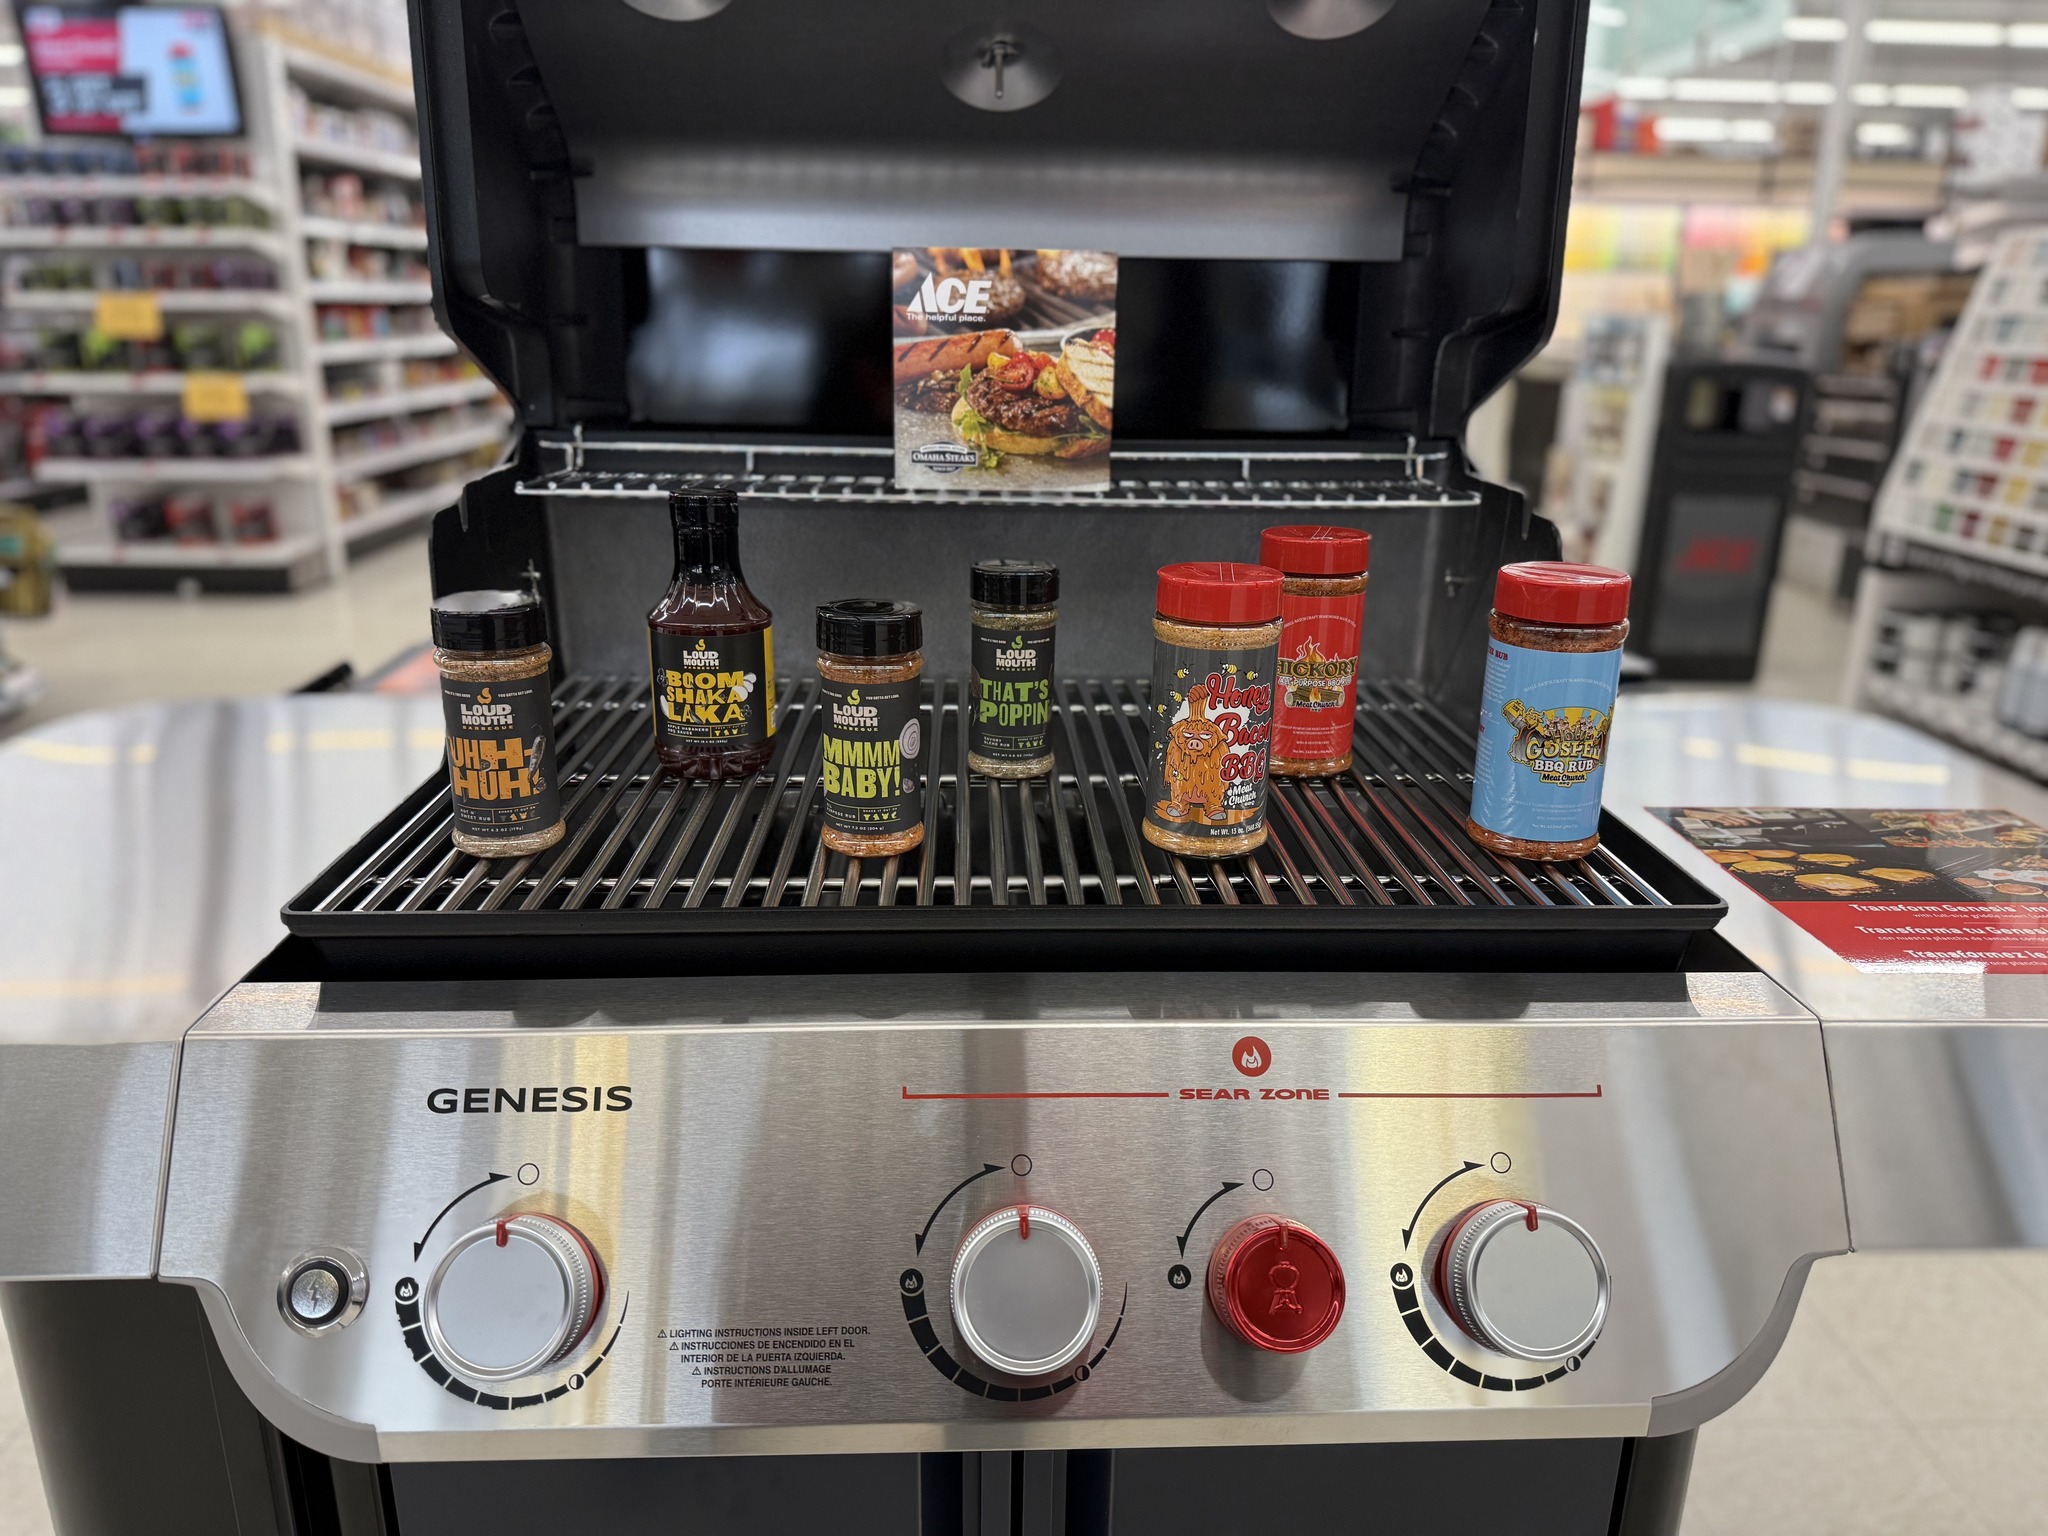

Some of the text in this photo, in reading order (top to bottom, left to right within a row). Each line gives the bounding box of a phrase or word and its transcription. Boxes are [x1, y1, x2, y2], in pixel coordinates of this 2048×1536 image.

[906, 271, 992, 314] ACE
[925, 313, 957, 322] helpful
[959, 314, 986, 322] place.
[912, 452, 975, 462] OMAHA STEAKS
[683, 650, 719, 659] LOUD
[996, 649, 1036, 659] LOUD
[996, 658, 1036, 667] MOUTH
[666, 670, 744, 689] BOOM
[1294, 679, 1326, 687] PURPOSE
[666, 686, 745, 705] SHAKA
[980, 678, 1049, 702] THAT'S
[1206, 673, 1270, 716] Honey
[460, 704, 512, 716] LOUD
[667, 701, 746, 724] LAKA
[833, 703, 878, 717] LOUD
[462, 714, 513, 726] MOUTH
[833, 714, 879, 727] MOUTH
[823, 733, 900, 768] MMMM
[1526, 739, 1601, 760] GOSPEL
[1533, 760, 1594, 773] BBQ RUB
[452, 766, 540, 801] HUH!
[823, 758, 900, 799] BABY!
[1561, 774, 1586, 782] Church
[1232, 783, 1253, 795] Meat
[1228, 791, 1257, 806] Church
[1210, 828, 1220, 836] Net
[1848, 904, 1943, 912] Transform
[1854, 926, 1963, 934] Transforma
[1903, 950, 2027, 958] Transformez
[427, 1086, 633, 1114] GENESIS
[1179, 1088, 1330, 1101] SEAR ZONE
[669, 1326, 871, 1338] LIGHTING INSTRUCTIONS INSIDE LEFT DOOR.
[681, 1339, 855, 1351] INSTRUCCIONES DE ENCENDIDO EN EL
[680, 1352, 846, 1363] INTERIOR DE LA PUERTA IZQUIERDA.
[703, 1364, 832, 1376] INSTRUCTIONS D'ALLUMAGE
[701, 1375, 832, 1388] PORTE INTÉRIEURE GAUCHE.
